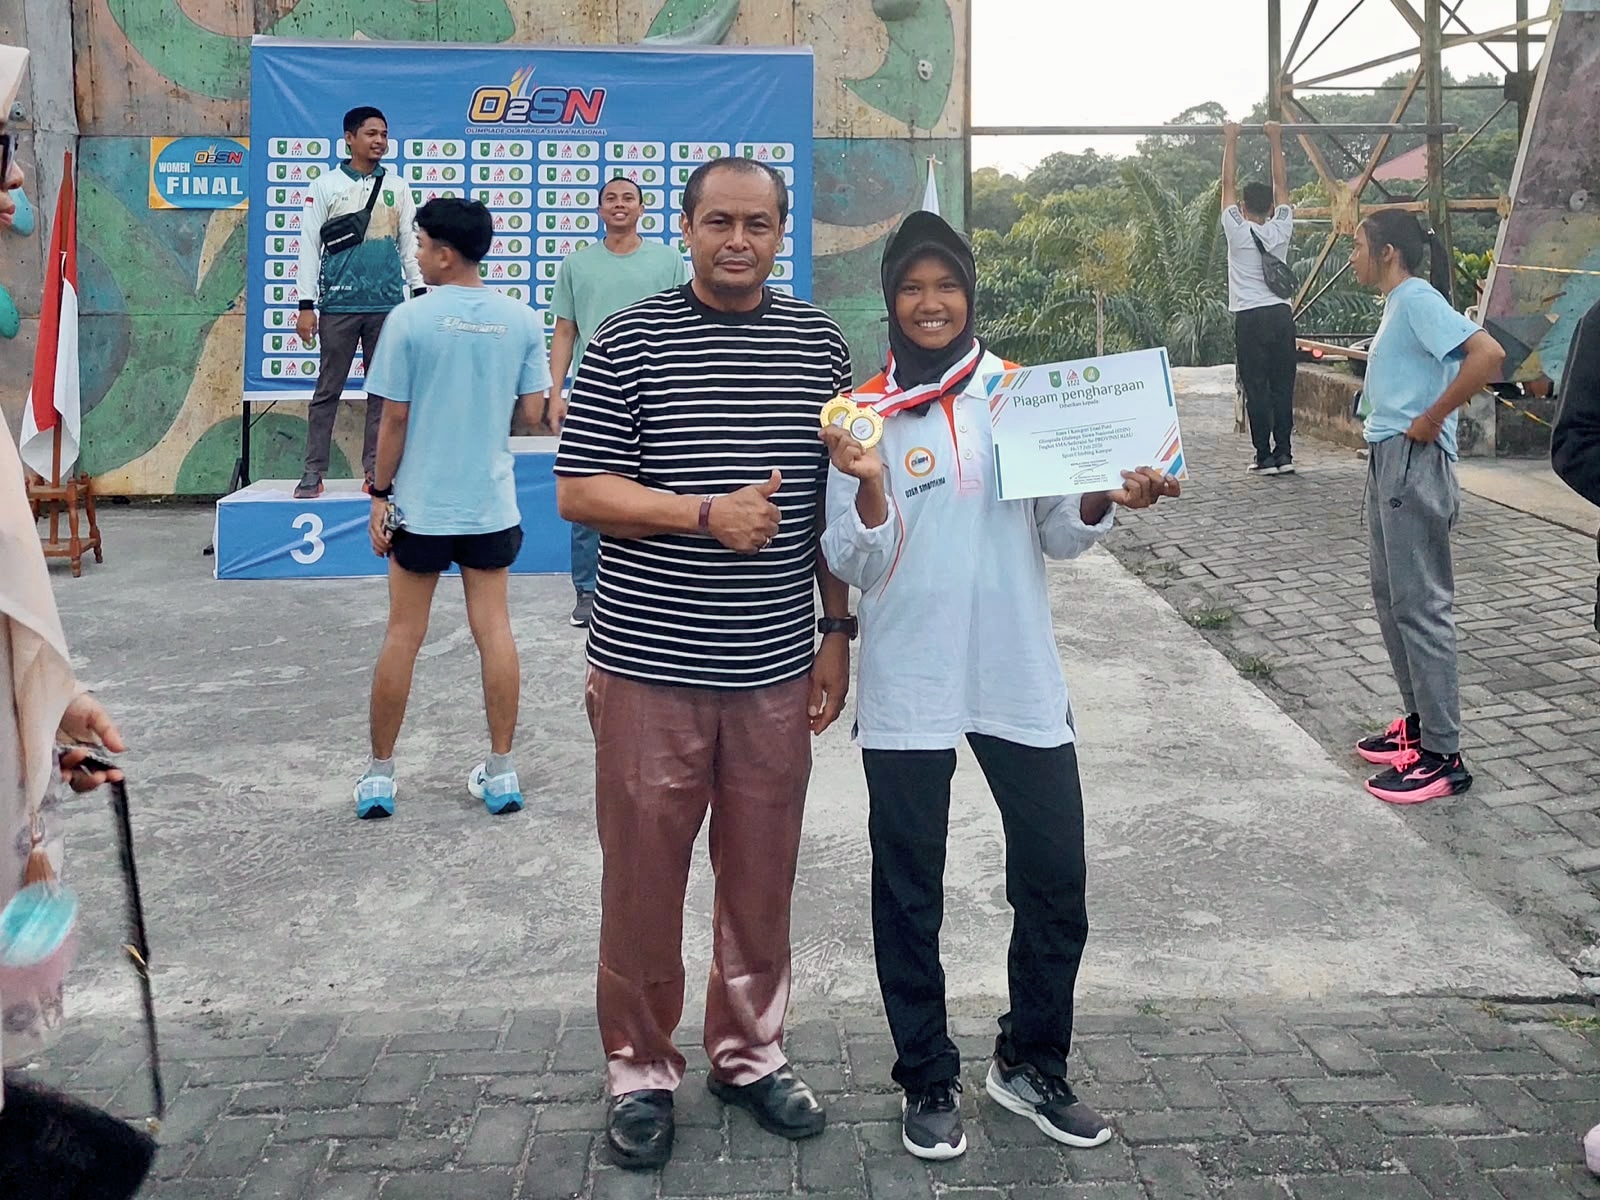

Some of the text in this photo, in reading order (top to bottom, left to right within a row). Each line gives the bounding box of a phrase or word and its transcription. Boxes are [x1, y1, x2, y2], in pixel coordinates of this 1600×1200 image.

[467, 85, 607, 126] O2SN
[465, 127, 607, 135] OLIMPIADE OLAHRAGA SISWA NASIONAL
[194, 150, 244, 165] O2SN
[158, 162, 191, 173] WOMEN
[166, 176, 244, 195] FINAL
[1012, 393, 1058, 408] Piagam
[1062, 380, 1144, 402] penghargaan
[290, 513, 325, 564] 3
